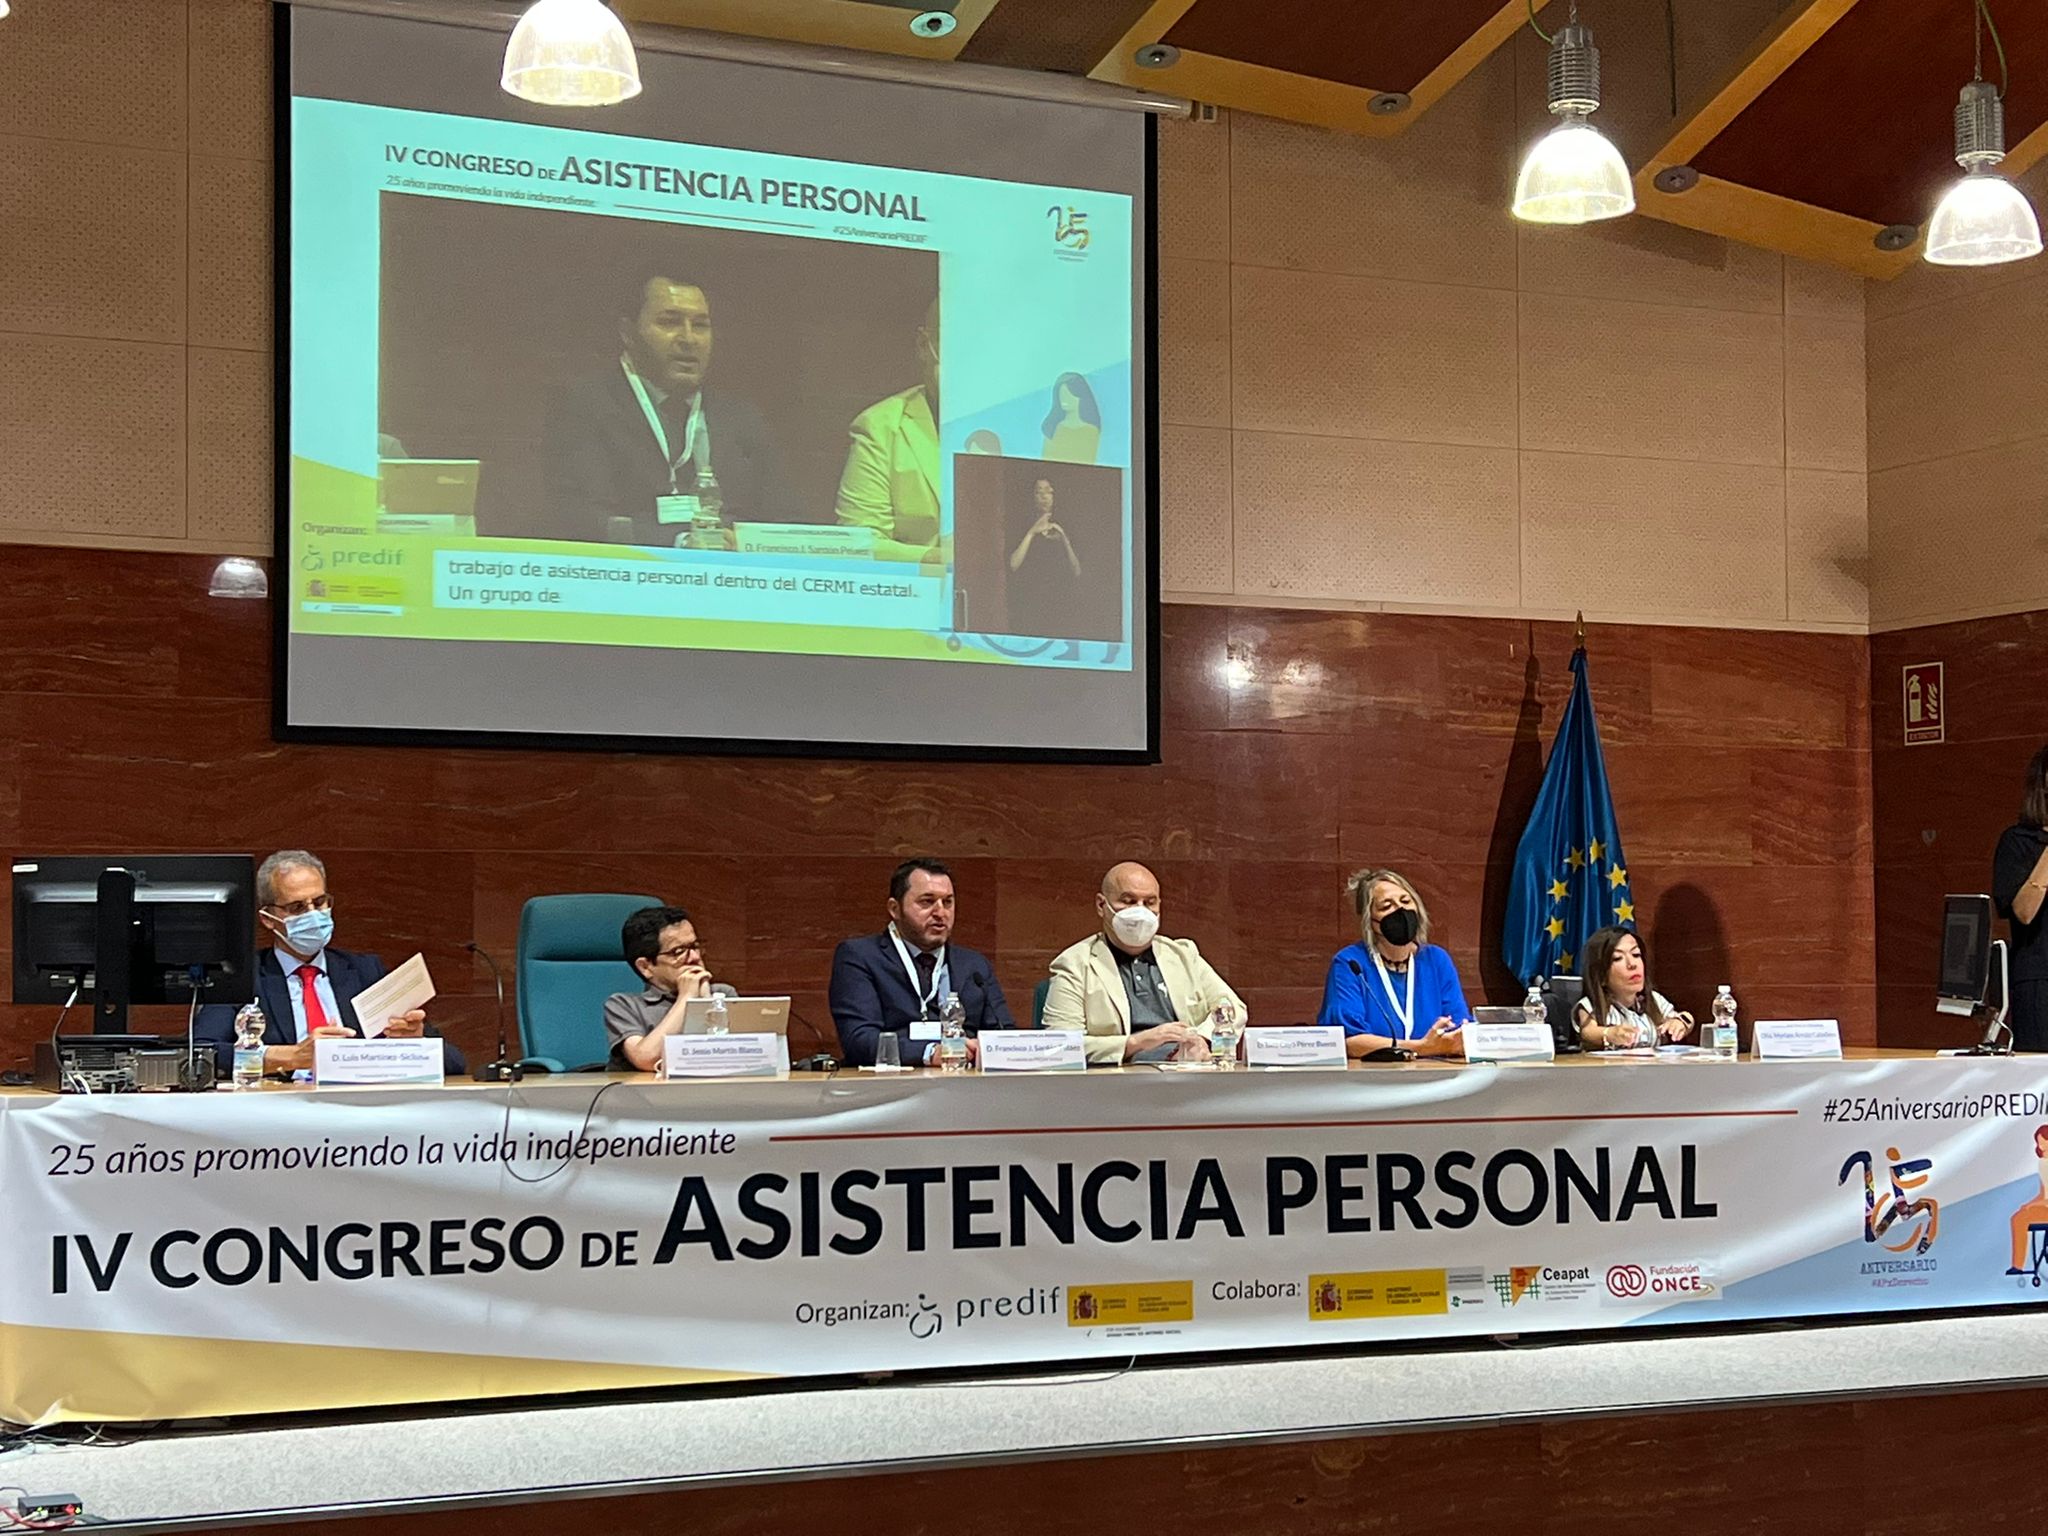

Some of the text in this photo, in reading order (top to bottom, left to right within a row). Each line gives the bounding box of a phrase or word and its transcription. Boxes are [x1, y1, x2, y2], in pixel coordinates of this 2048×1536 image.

[385, 144, 928, 223] IV CONGRESO DE ASISTENCIA PERSONAL
[386, 174, 401, 186] 25
[504, 188, 526, 200] vida
[331, 548, 404, 567] predif
[449, 560, 920, 598] trabajo de asistencia personal dentro del CERMI estatal.
[449, 586, 561, 604] Un grupo de
[48, 1126, 737, 1178] 25 años promoviendo la vida independiente
[51, 1143, 1718, 1295] IV CONGRESO DE ASISTENCIA PERSONAL
[1542, 1266, 1590, 1283] Ceapat
[1650, 1265, 1700, 1275] Fundación
[1860, 1258, 1938, 1275] ANIVERSARIO
[1211, 1278, 1301, 1301] Colabora:
[1651, 1276, 1701, 1292] ONCE
[795, 1286, 1061, 1328] Organizan: predif
